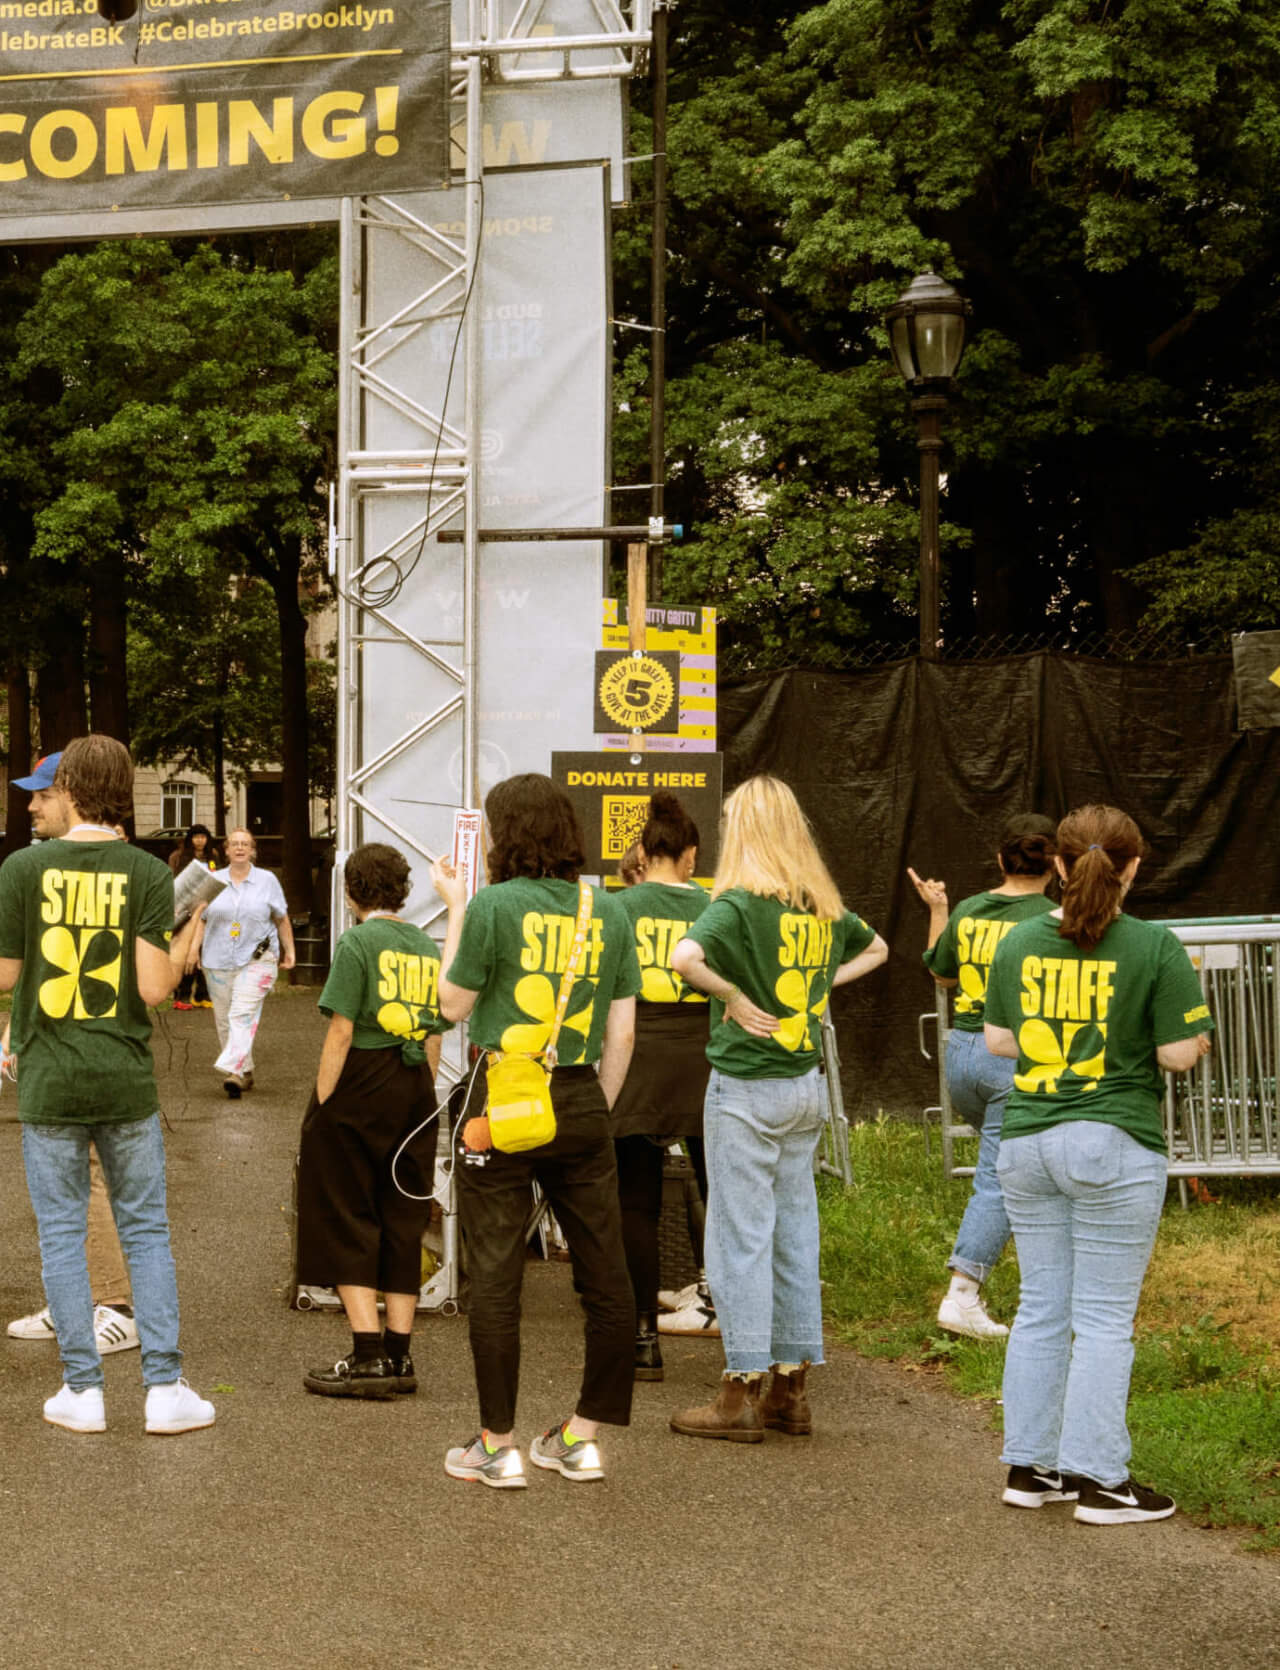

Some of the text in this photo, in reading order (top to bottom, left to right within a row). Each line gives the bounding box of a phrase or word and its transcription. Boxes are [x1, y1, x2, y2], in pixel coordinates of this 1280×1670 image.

[139, 5, 395, 46] #CelebrateBrooklyn
[610, 662, 664, 684] KEEP IT GREAT
[624, 678, 653, 707] 5
[620, 709, 632, 721] AT
[635, 709, 652, 722] THE
[650, 693, 668, 714] GATE
[567, 771, 707, 788] DONATE HERE
[458, 820, 478, 832] FIRE
[41, 868, 127, 926] STAFF
[1020, 955, 1117, 1021] STAFF
